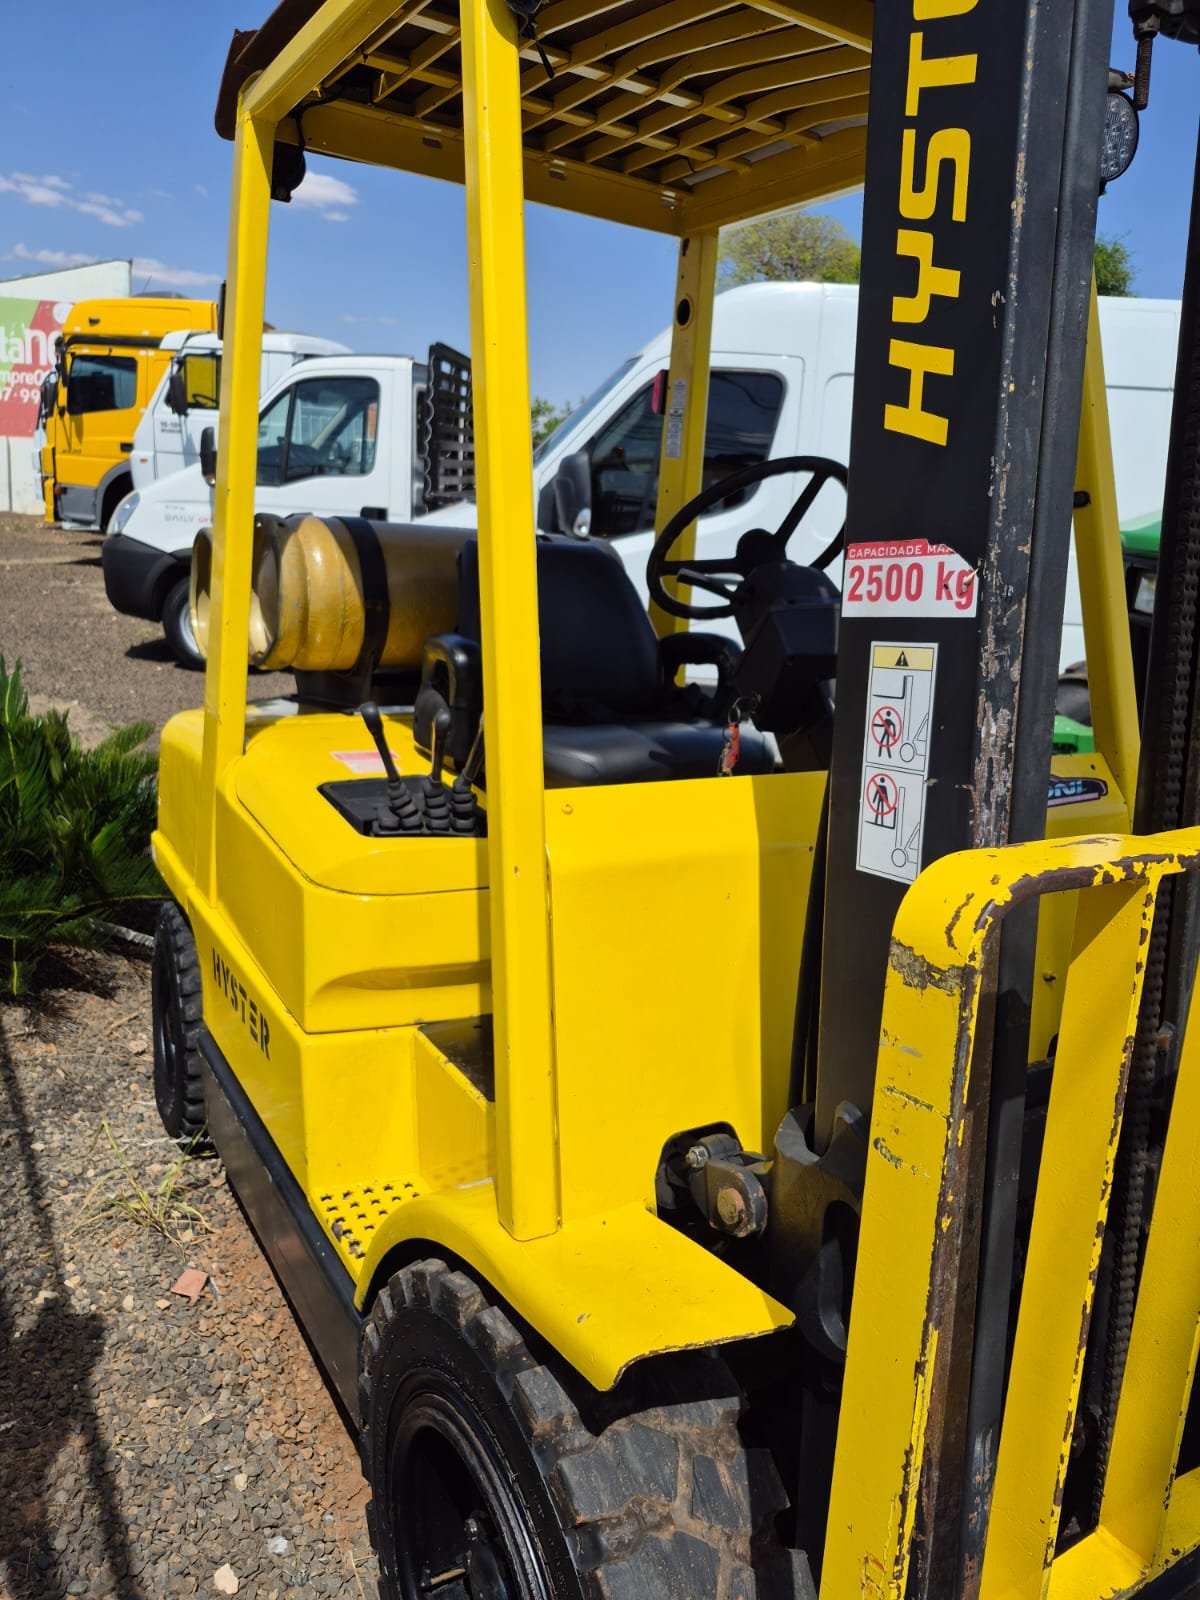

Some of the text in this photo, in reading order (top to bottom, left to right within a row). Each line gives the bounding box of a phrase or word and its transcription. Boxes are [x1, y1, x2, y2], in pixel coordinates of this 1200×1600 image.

[883, 0, 979, 446] HYST
[847, 561, 976, 611] 2500 kg
[849, 545, 923, 559] CAPACIDADE
[211, 946, 271, 1063] HYSTER
